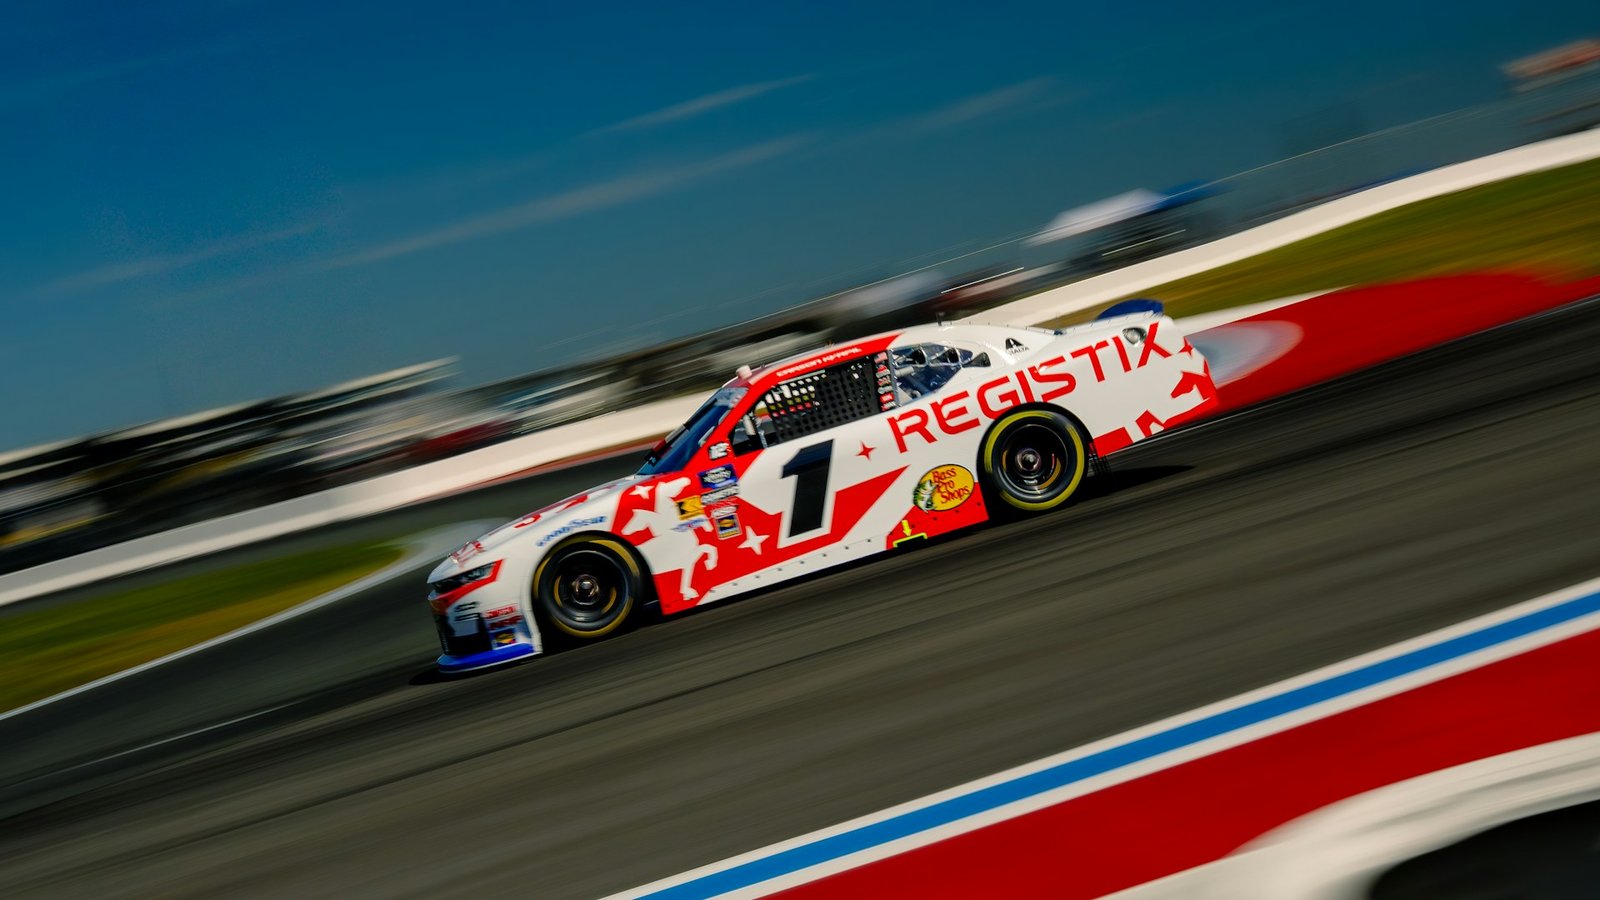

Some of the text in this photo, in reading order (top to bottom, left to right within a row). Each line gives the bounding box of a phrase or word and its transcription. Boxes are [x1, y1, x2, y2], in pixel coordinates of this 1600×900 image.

[887, 322, 1172, 454] REGISTIX
[932, 468, 957, 482] Bass
[781, 439, 834, 538] 1
[936, 480, 955, 493] Pro
[941, 485, 970, 504] Shops
